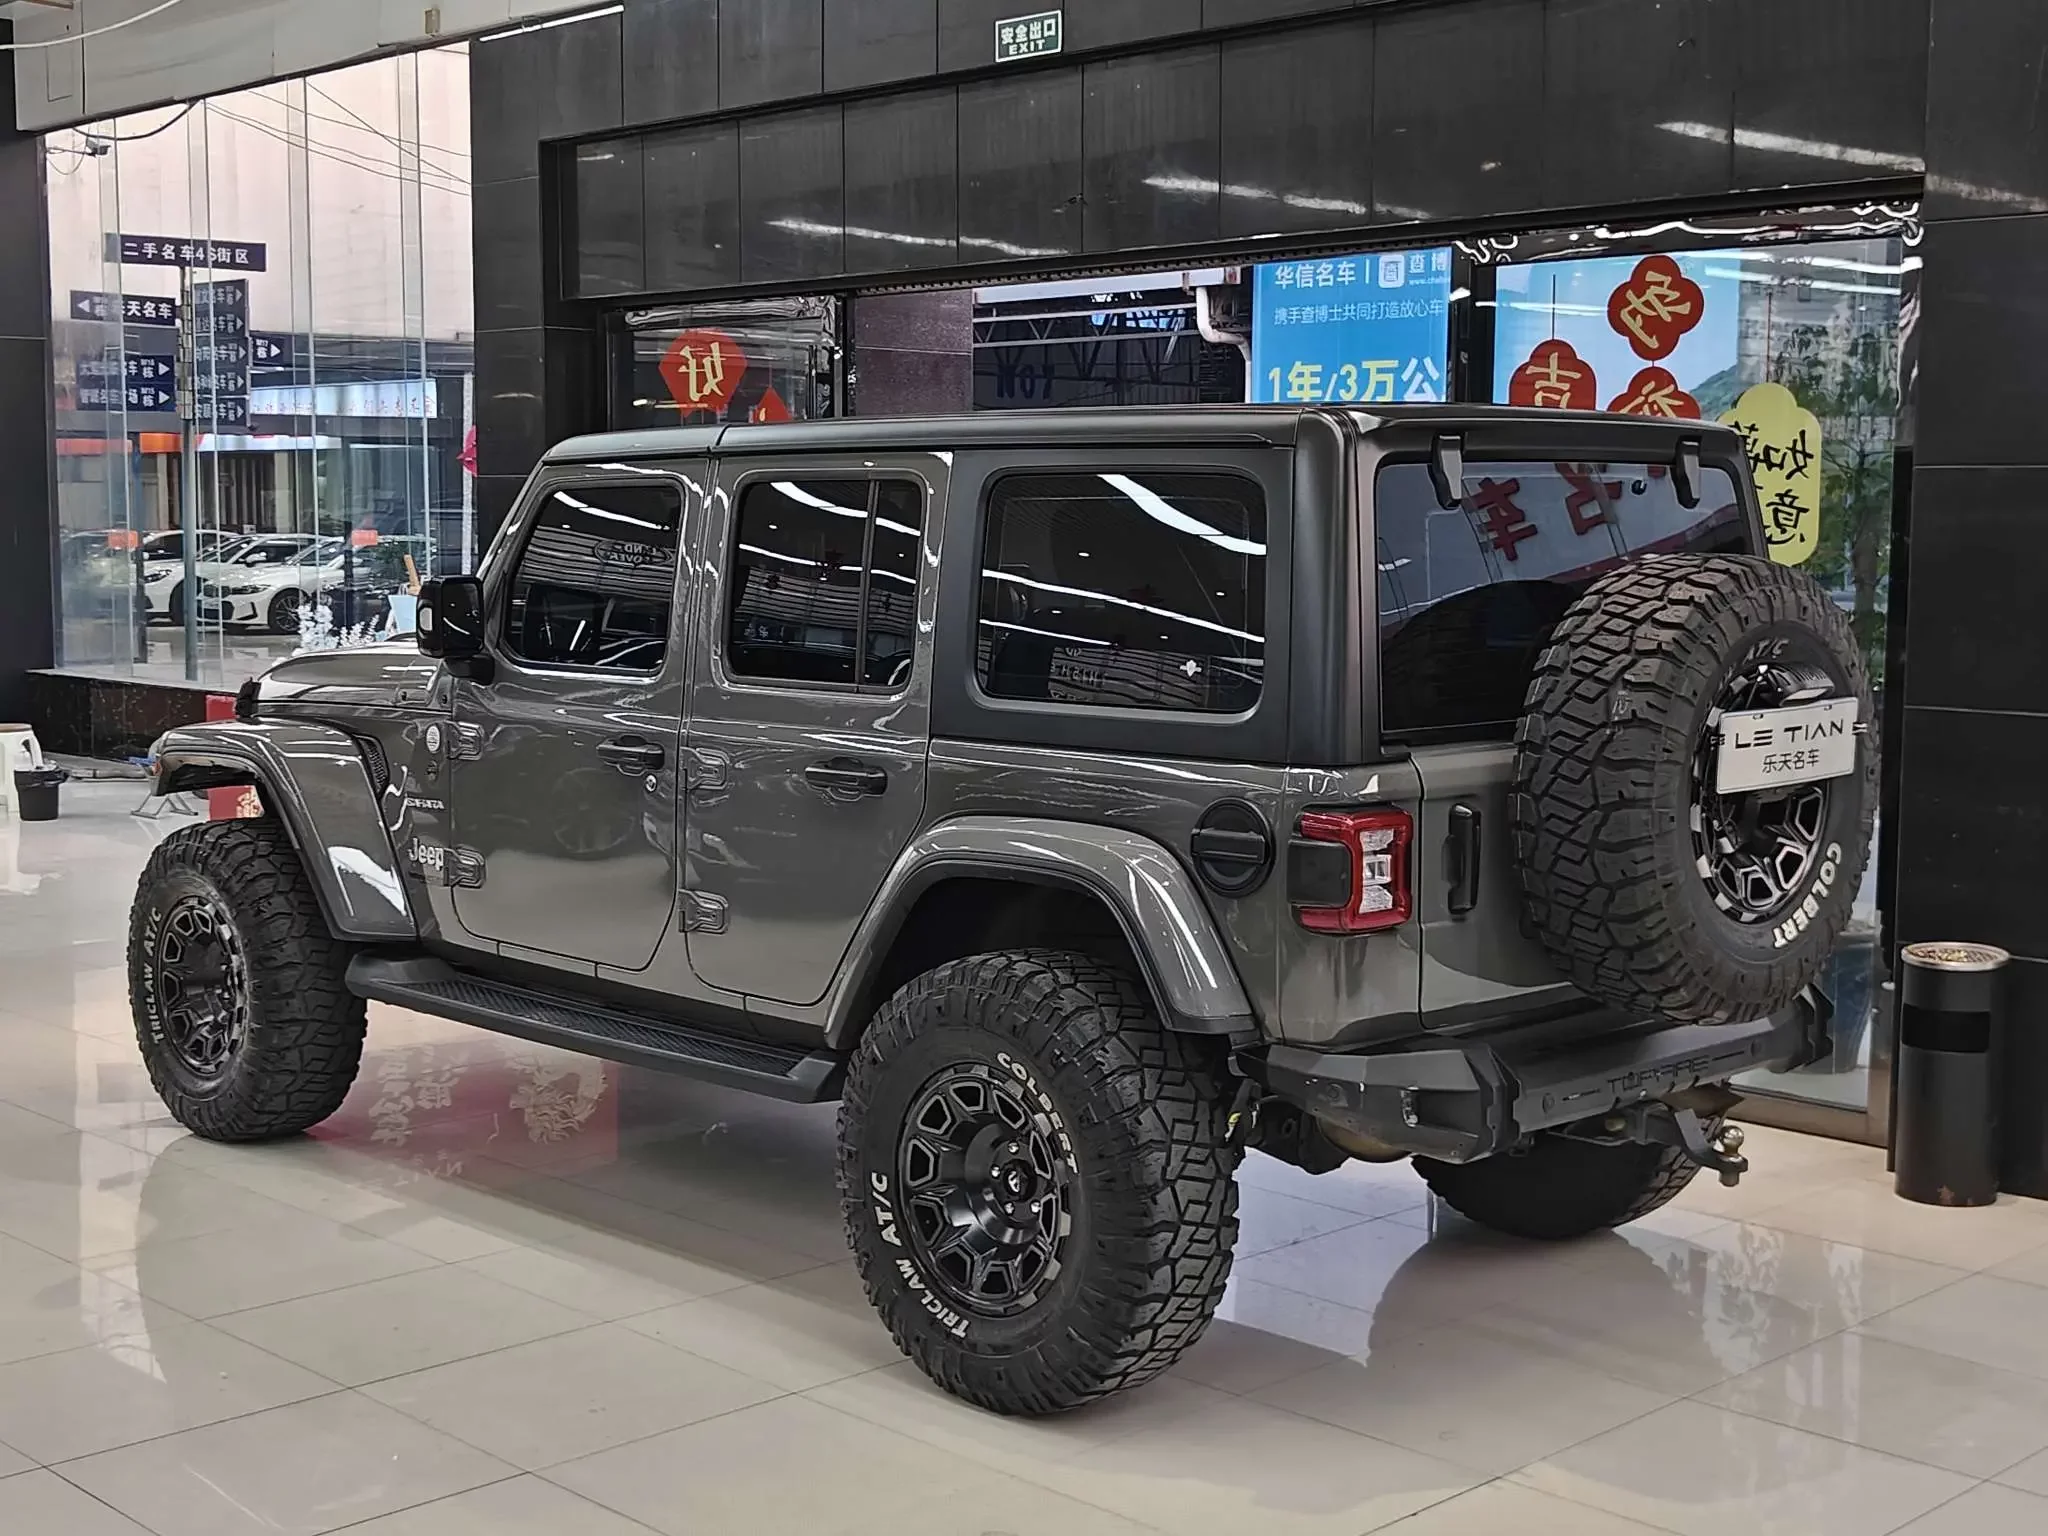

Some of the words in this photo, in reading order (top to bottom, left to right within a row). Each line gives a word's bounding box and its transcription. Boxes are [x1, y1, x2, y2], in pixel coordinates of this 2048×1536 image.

[1001, 18, 1056, 45] 安全出口
[1008, 39, 1046, 56] EXIT
[123, 242, 249, 265] 二手名车4S街区
[1274, 262, 1356, 290] 华信名车
[119, 300, 174, 320] 天名车
[1273, 298, 1445, 326] 携手查博士共同打造放心车
[1734, 728, 1773, 750] LE
[1783, 718, 1844, 744] TIAN
[1761, 748, 1821, 775] 乐天名车
[407, 836, 445, 872] Jeep
[1772, 841, 1842, 949] COLBERT
[996, 1051, 1079, 1175] COLBERT
[870, 1171, 903, 1247] AT/C
[894, 1257, 971, 1340] TRICLAW
